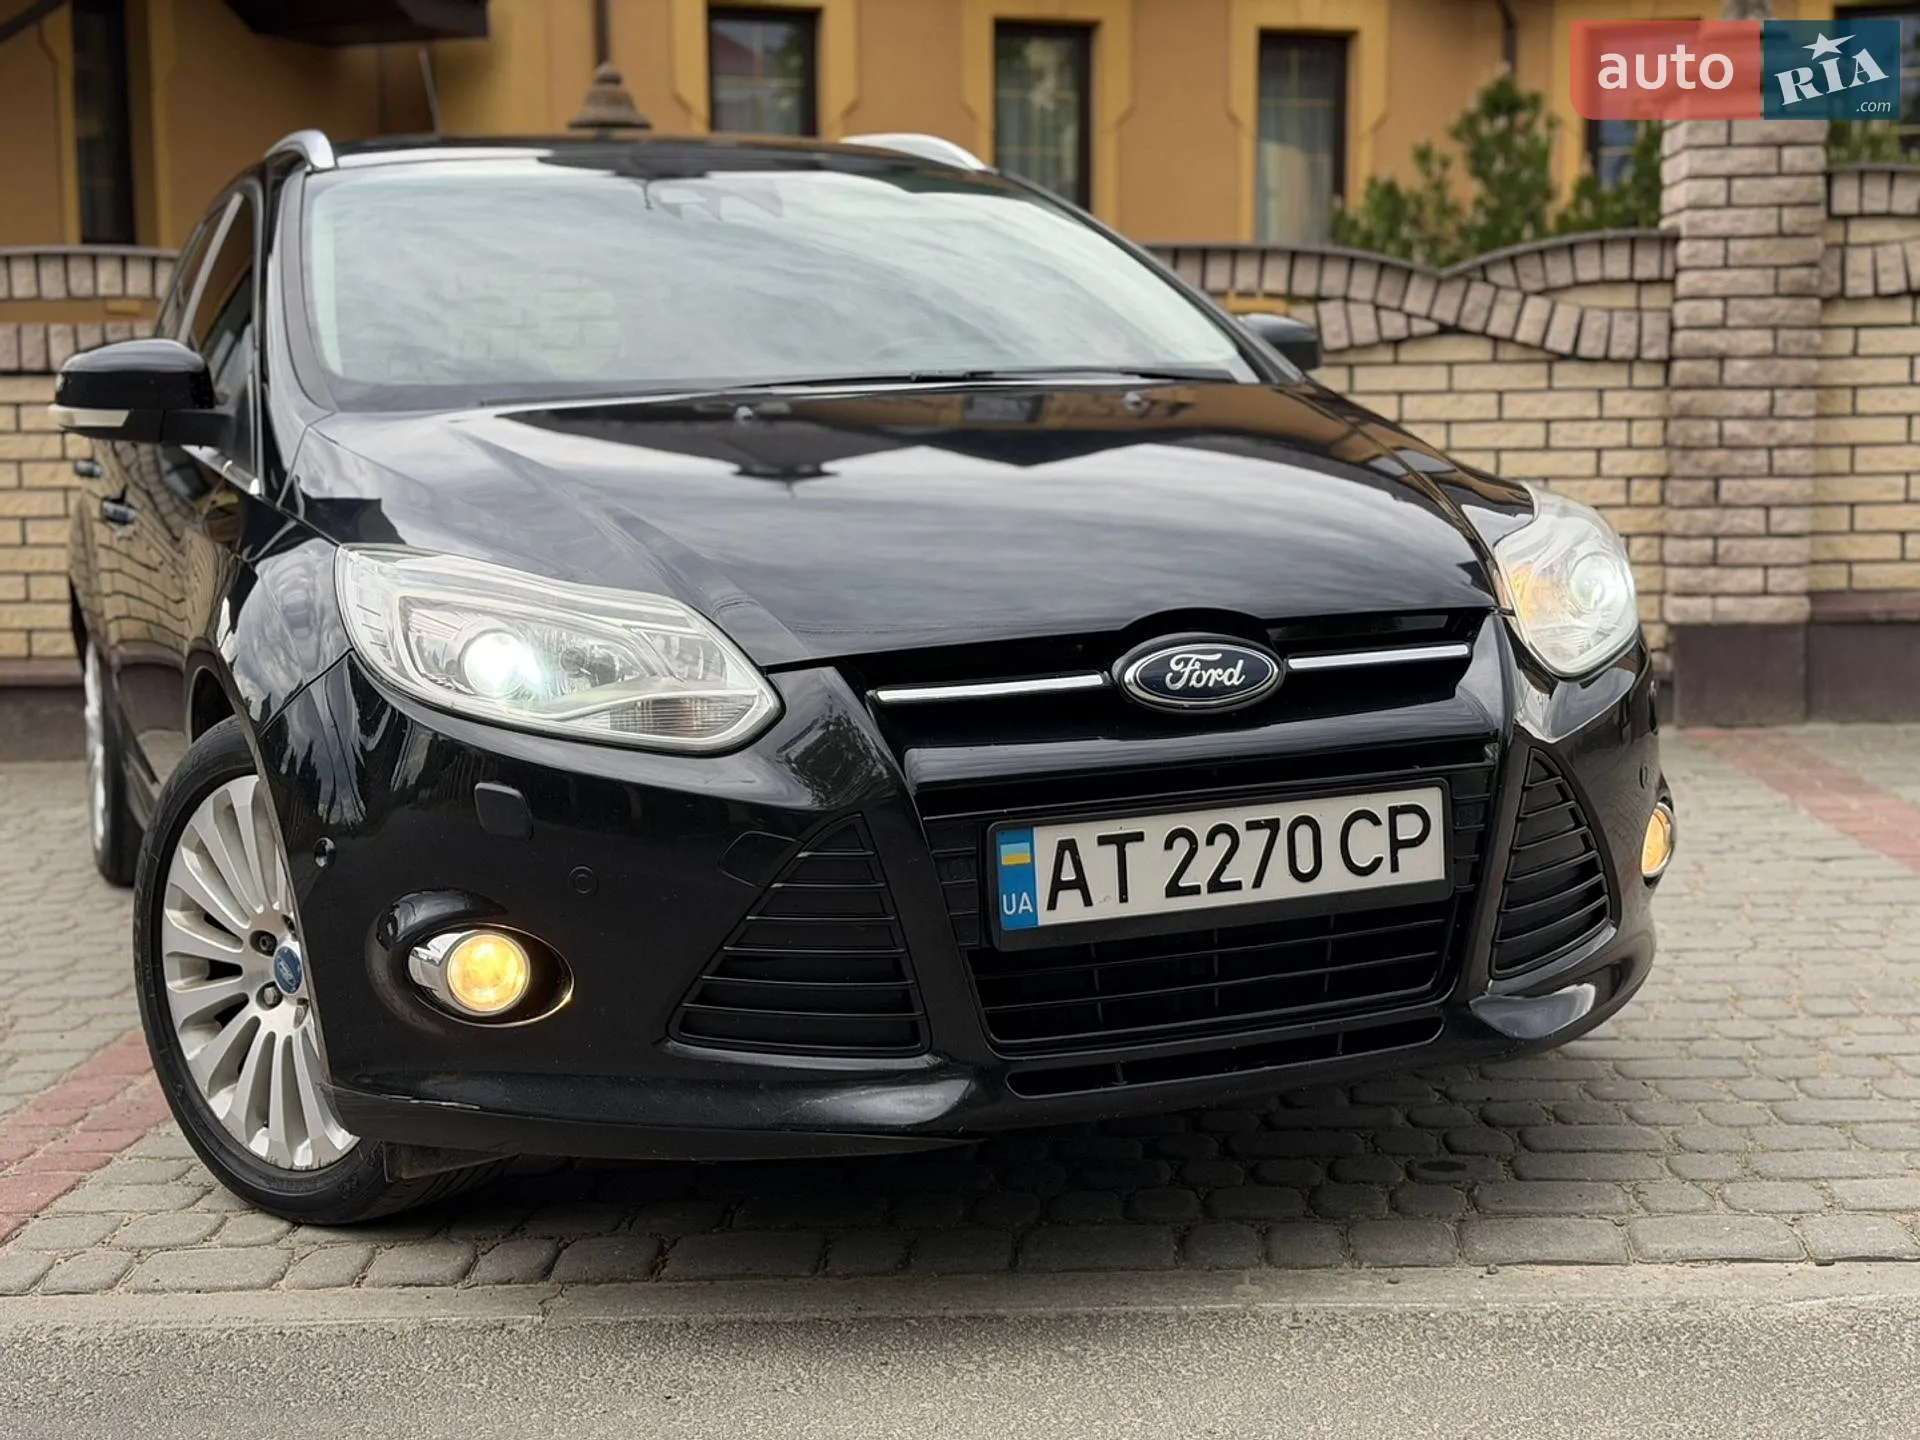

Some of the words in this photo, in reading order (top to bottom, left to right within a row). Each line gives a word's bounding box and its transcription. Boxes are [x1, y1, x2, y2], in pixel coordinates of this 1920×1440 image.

[1165, 653, 1246, 690] Ford
[1046, 831, 1145, 912] AT
[1163, 814, 1323, 899] 2270
[1340, 803, 1431, 877] CP
[1002, 893, 1033, 915] UA
